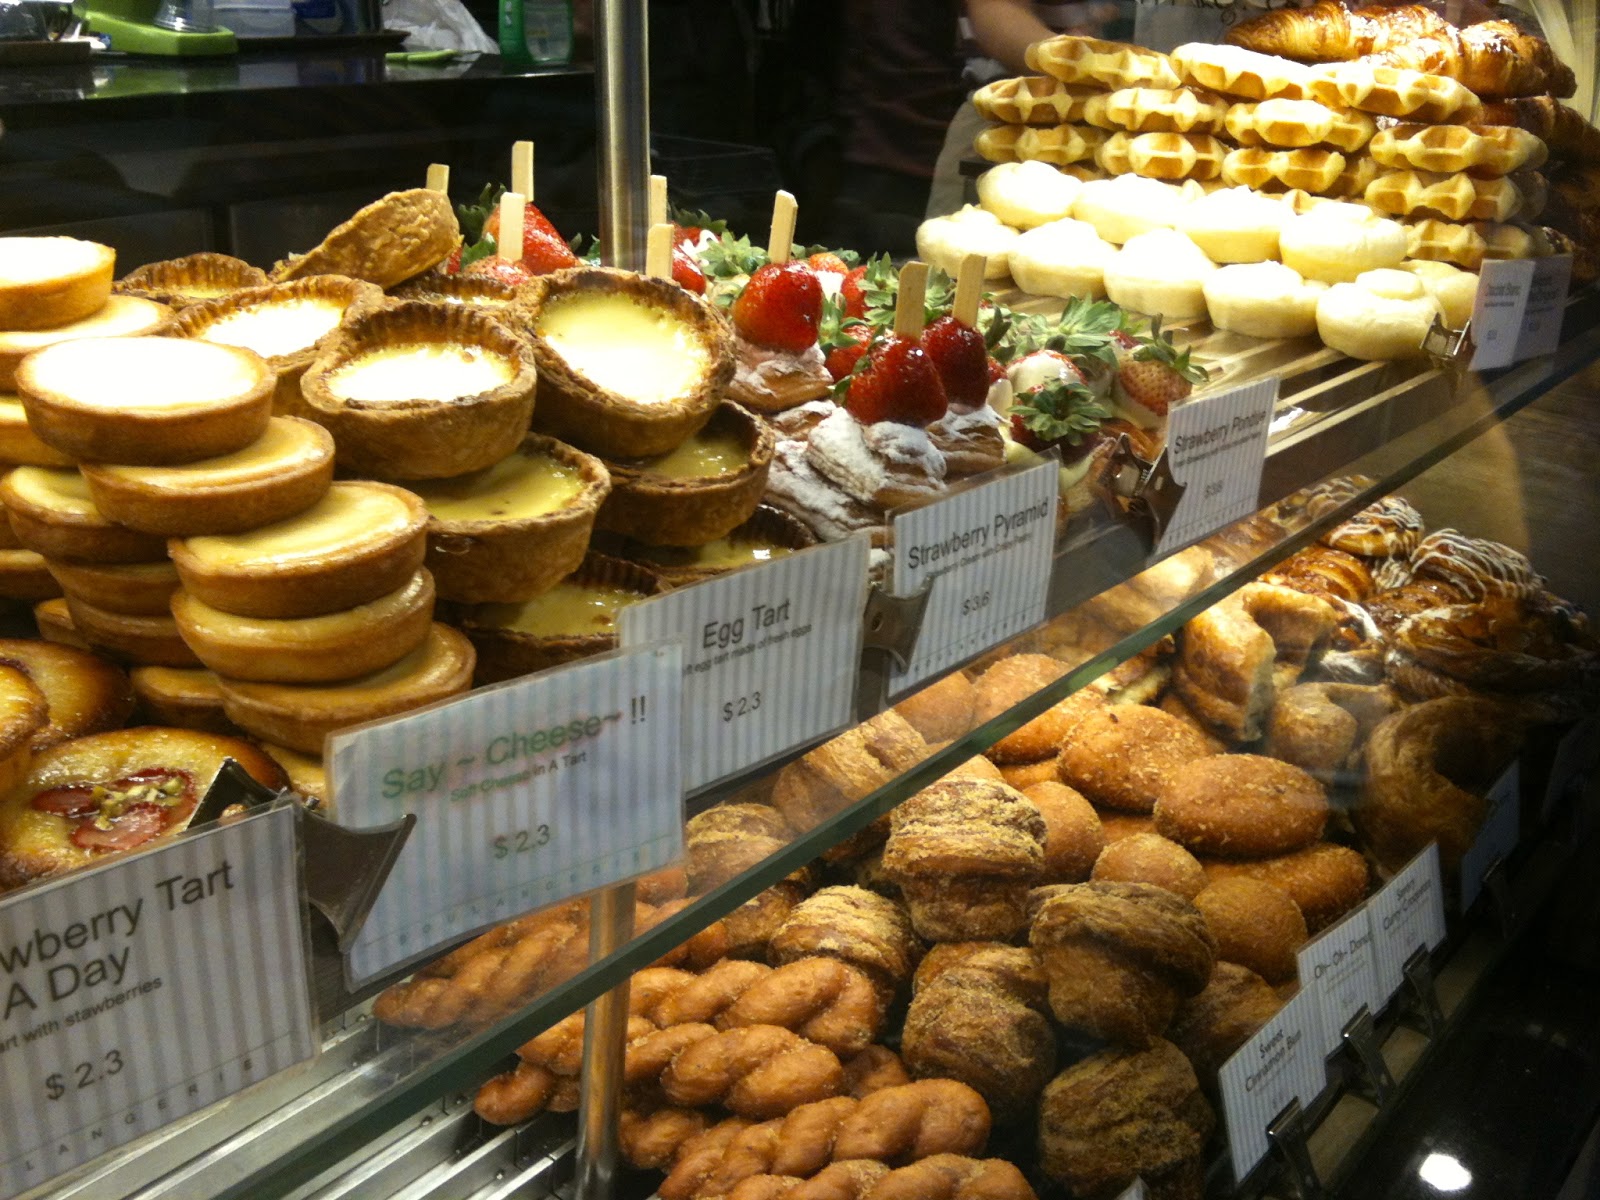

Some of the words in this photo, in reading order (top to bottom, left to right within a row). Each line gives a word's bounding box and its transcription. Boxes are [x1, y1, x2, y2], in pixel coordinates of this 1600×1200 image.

[908, 523, 989, 570] Strawberry
[993, 496, 1049, 538] Pyramid
[702, 617, 744, 651] Egg
[752, 598, 790, 632] Tart
[381, 764, 446, 800] Say
[562, 752, 588, 769] Tart
[155, 861, 235, 911] Tart
[3, 982, 37, 1021] A
[48, 945, 131, 1002] Day
[23, 1019, 60, 1044] with
